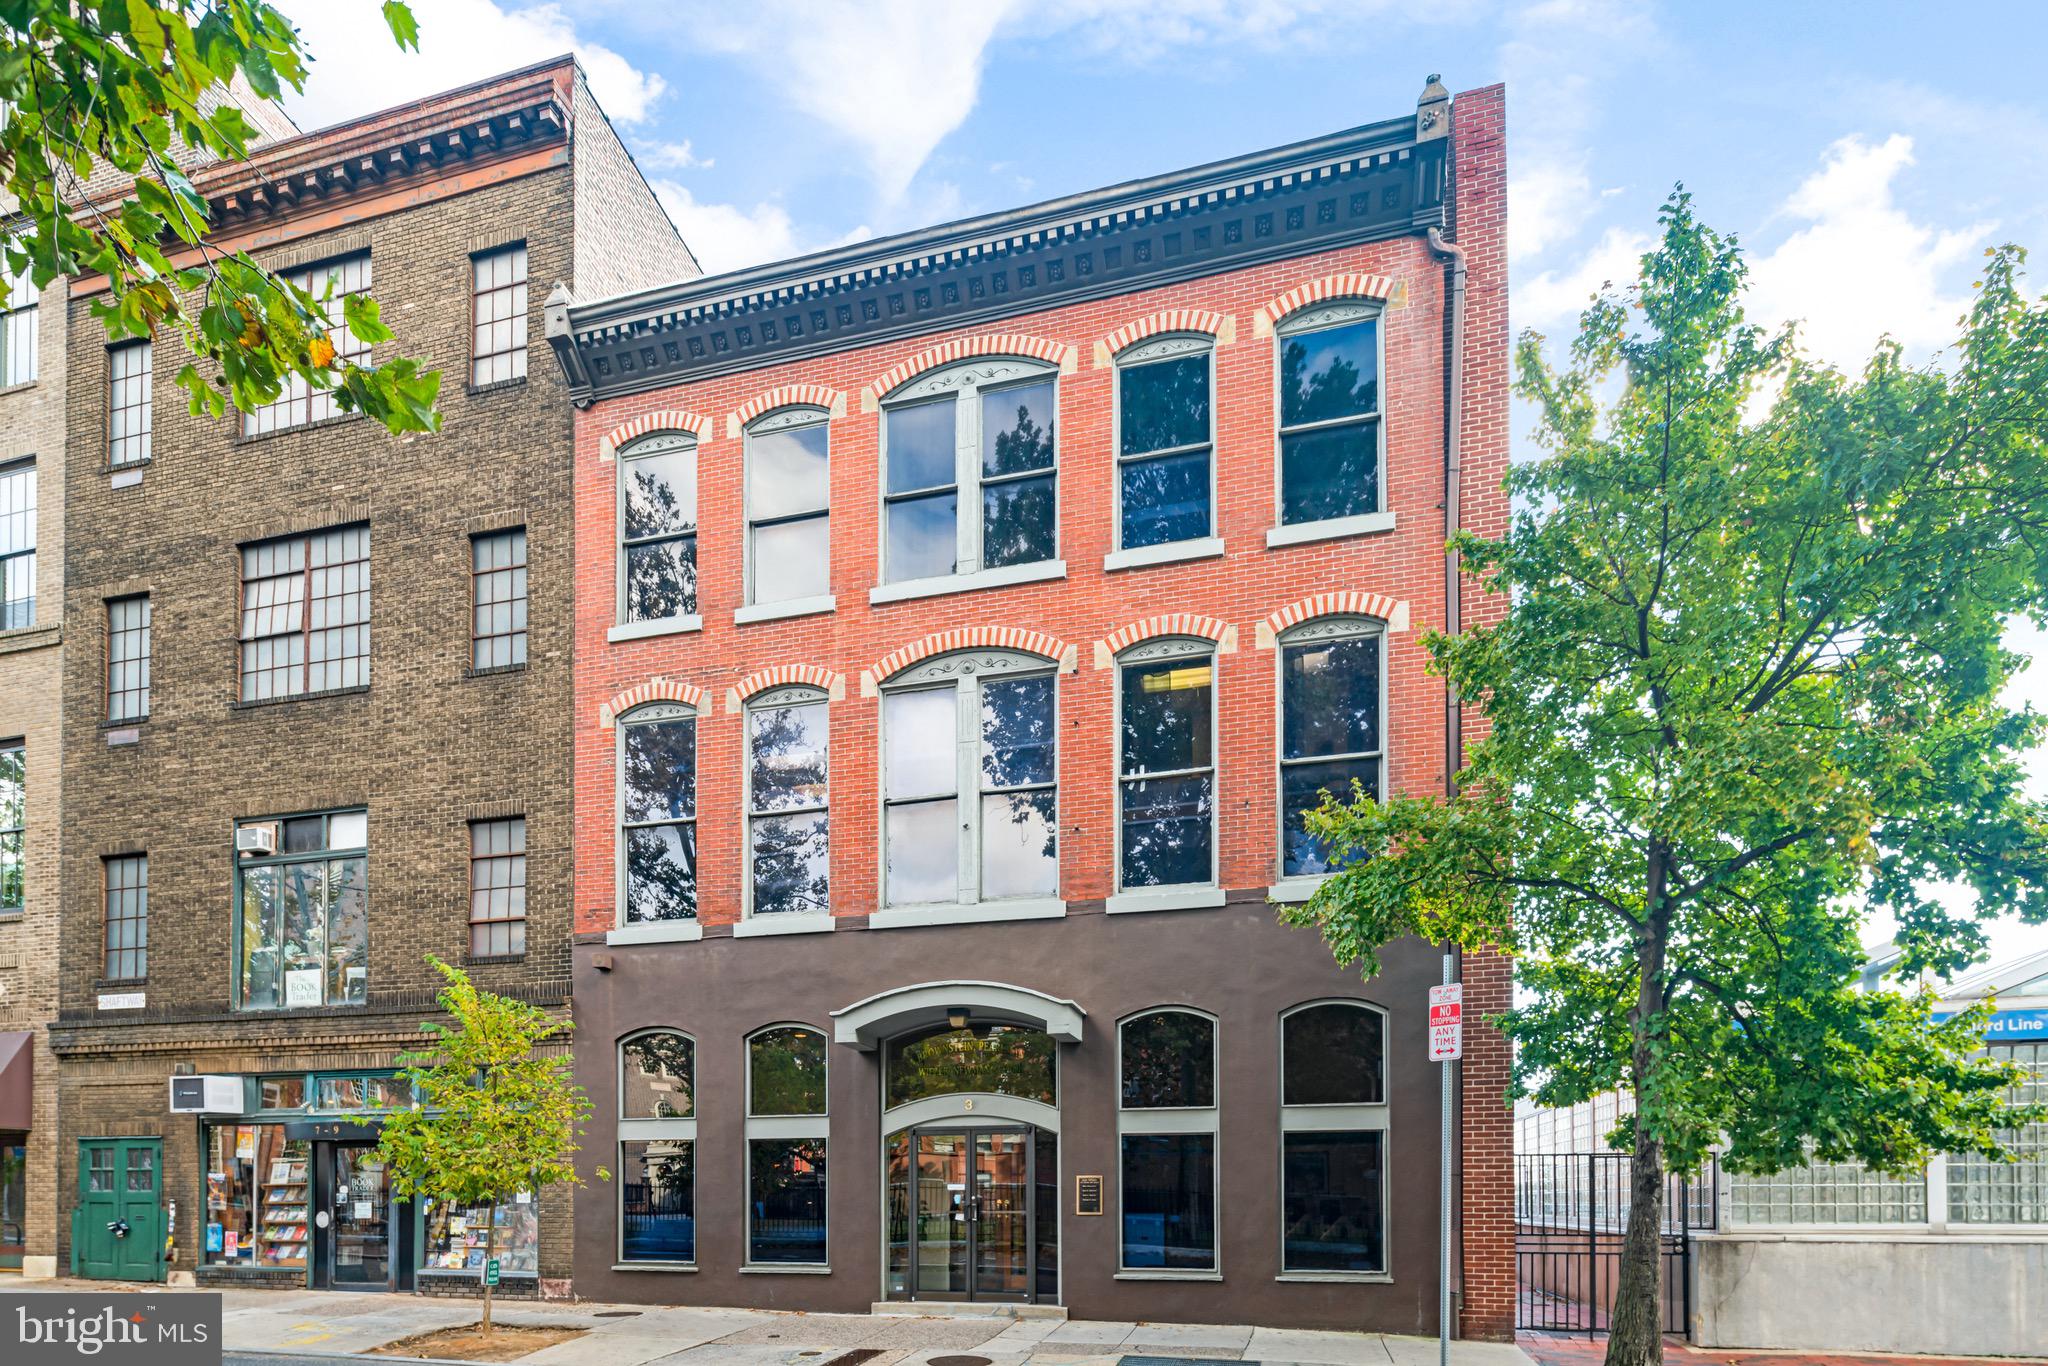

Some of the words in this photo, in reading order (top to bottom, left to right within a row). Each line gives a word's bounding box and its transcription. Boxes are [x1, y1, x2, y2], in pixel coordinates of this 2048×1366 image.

[291, 983, 317, 991] BOOK
[1440, 1006, 1451, 1016] NO
[1431, 1016, 1460, 1026] STOPPING
[2008, 1018, 2043, 1031] Line
[1435, 1026, 1455, 1036] ANY
[1435, 1036, 1456, 1046] TIME
[964, 1099, 973, 1111] 3
[352, 1178, 374, 1186] BOOK
